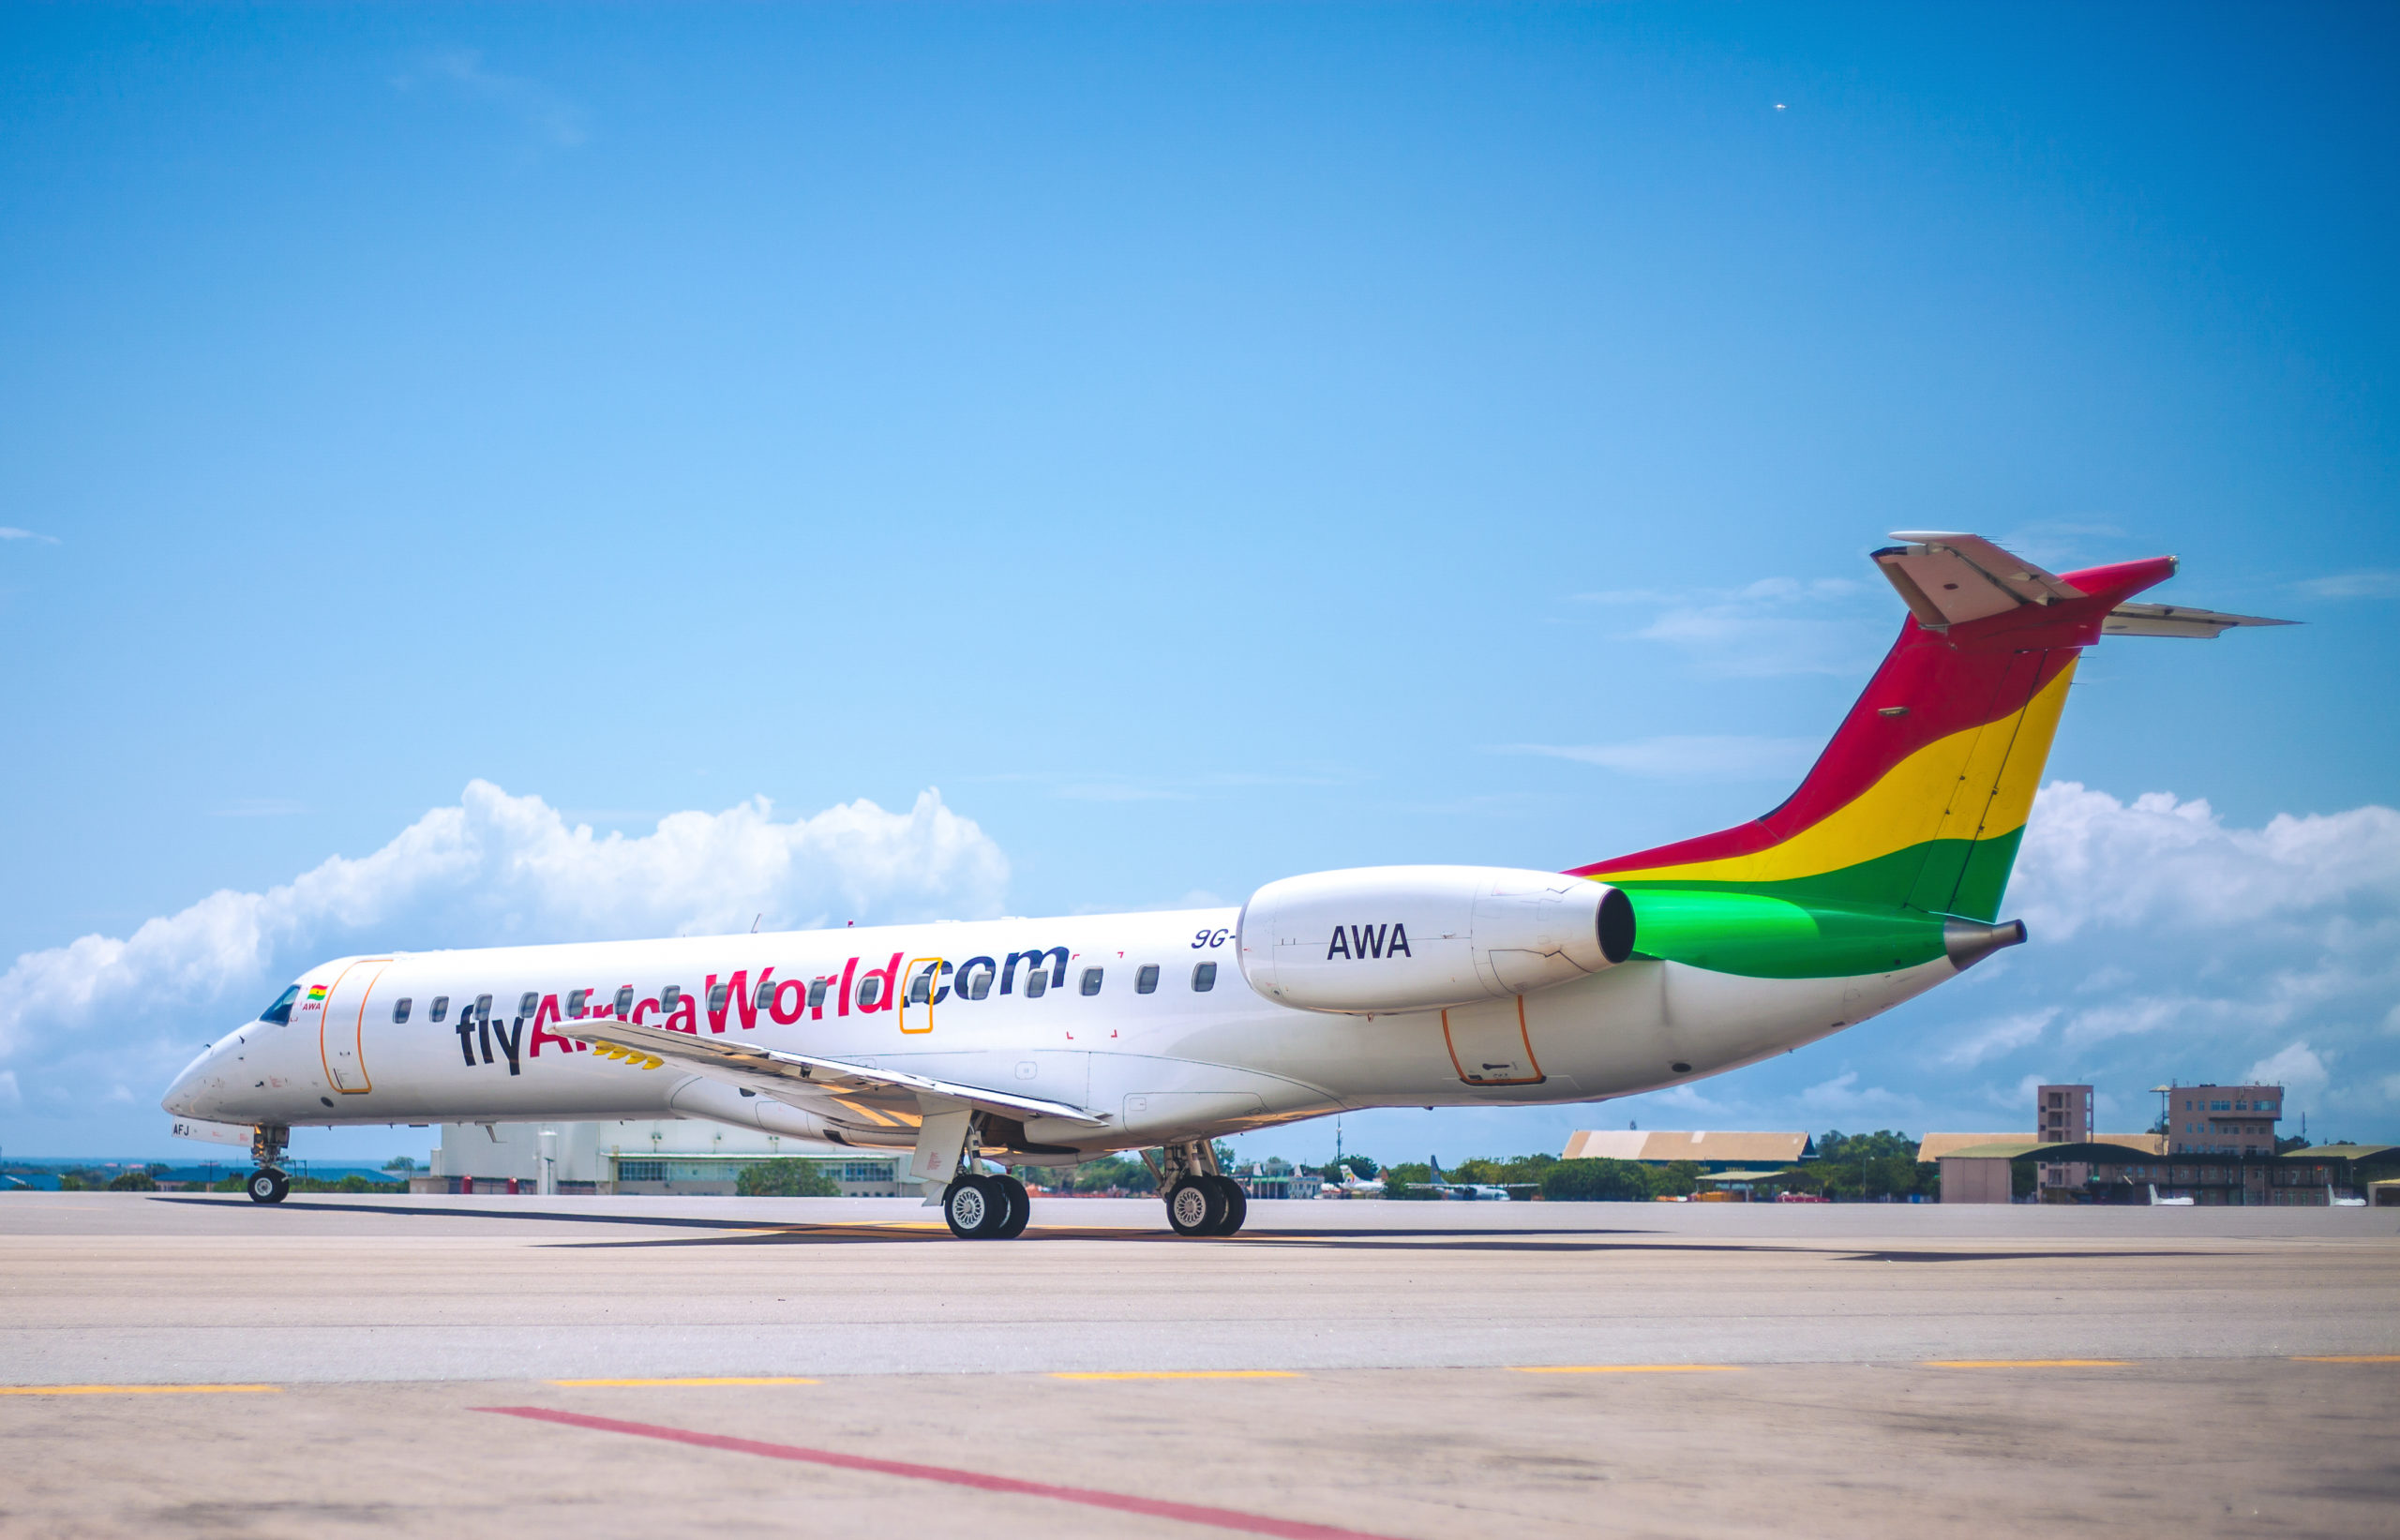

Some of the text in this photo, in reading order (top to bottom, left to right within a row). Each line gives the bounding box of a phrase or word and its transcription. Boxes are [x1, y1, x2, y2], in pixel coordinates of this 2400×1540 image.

[1327, 923, 1412, 961] AWA
[302, 1002, 321, 1011] AWA
[456, 946, 1070, 1077] flyAcaWorld.com
[172, 1123, 189, 1137] AFJ
